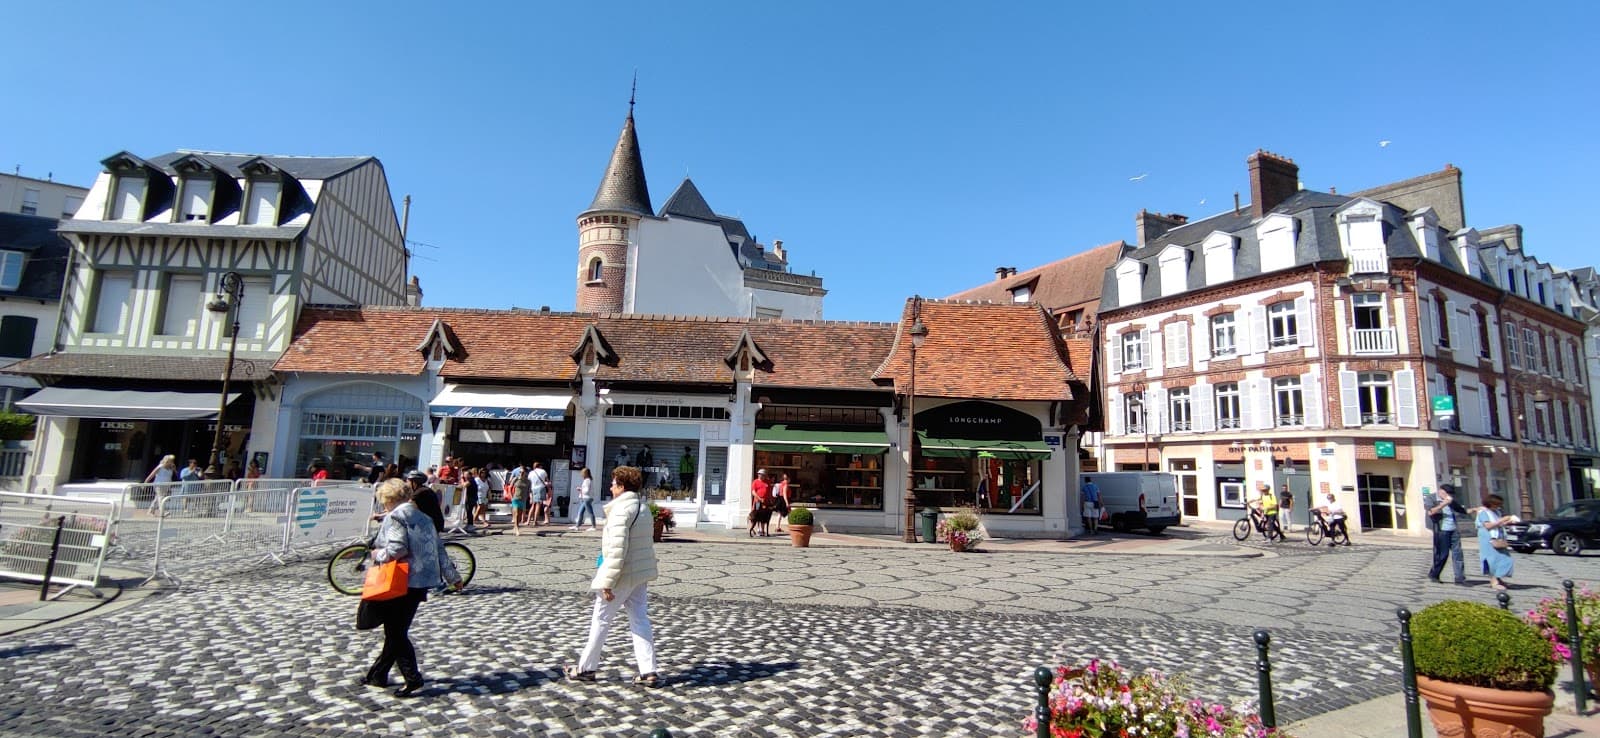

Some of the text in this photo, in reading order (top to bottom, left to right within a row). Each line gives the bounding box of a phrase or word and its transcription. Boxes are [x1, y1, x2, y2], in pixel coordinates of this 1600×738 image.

[448, 406, 495, 418] Martine
[499, 407, 547, 420] Lambert
[949, 416, 1002, 424] LONGCHAMP
